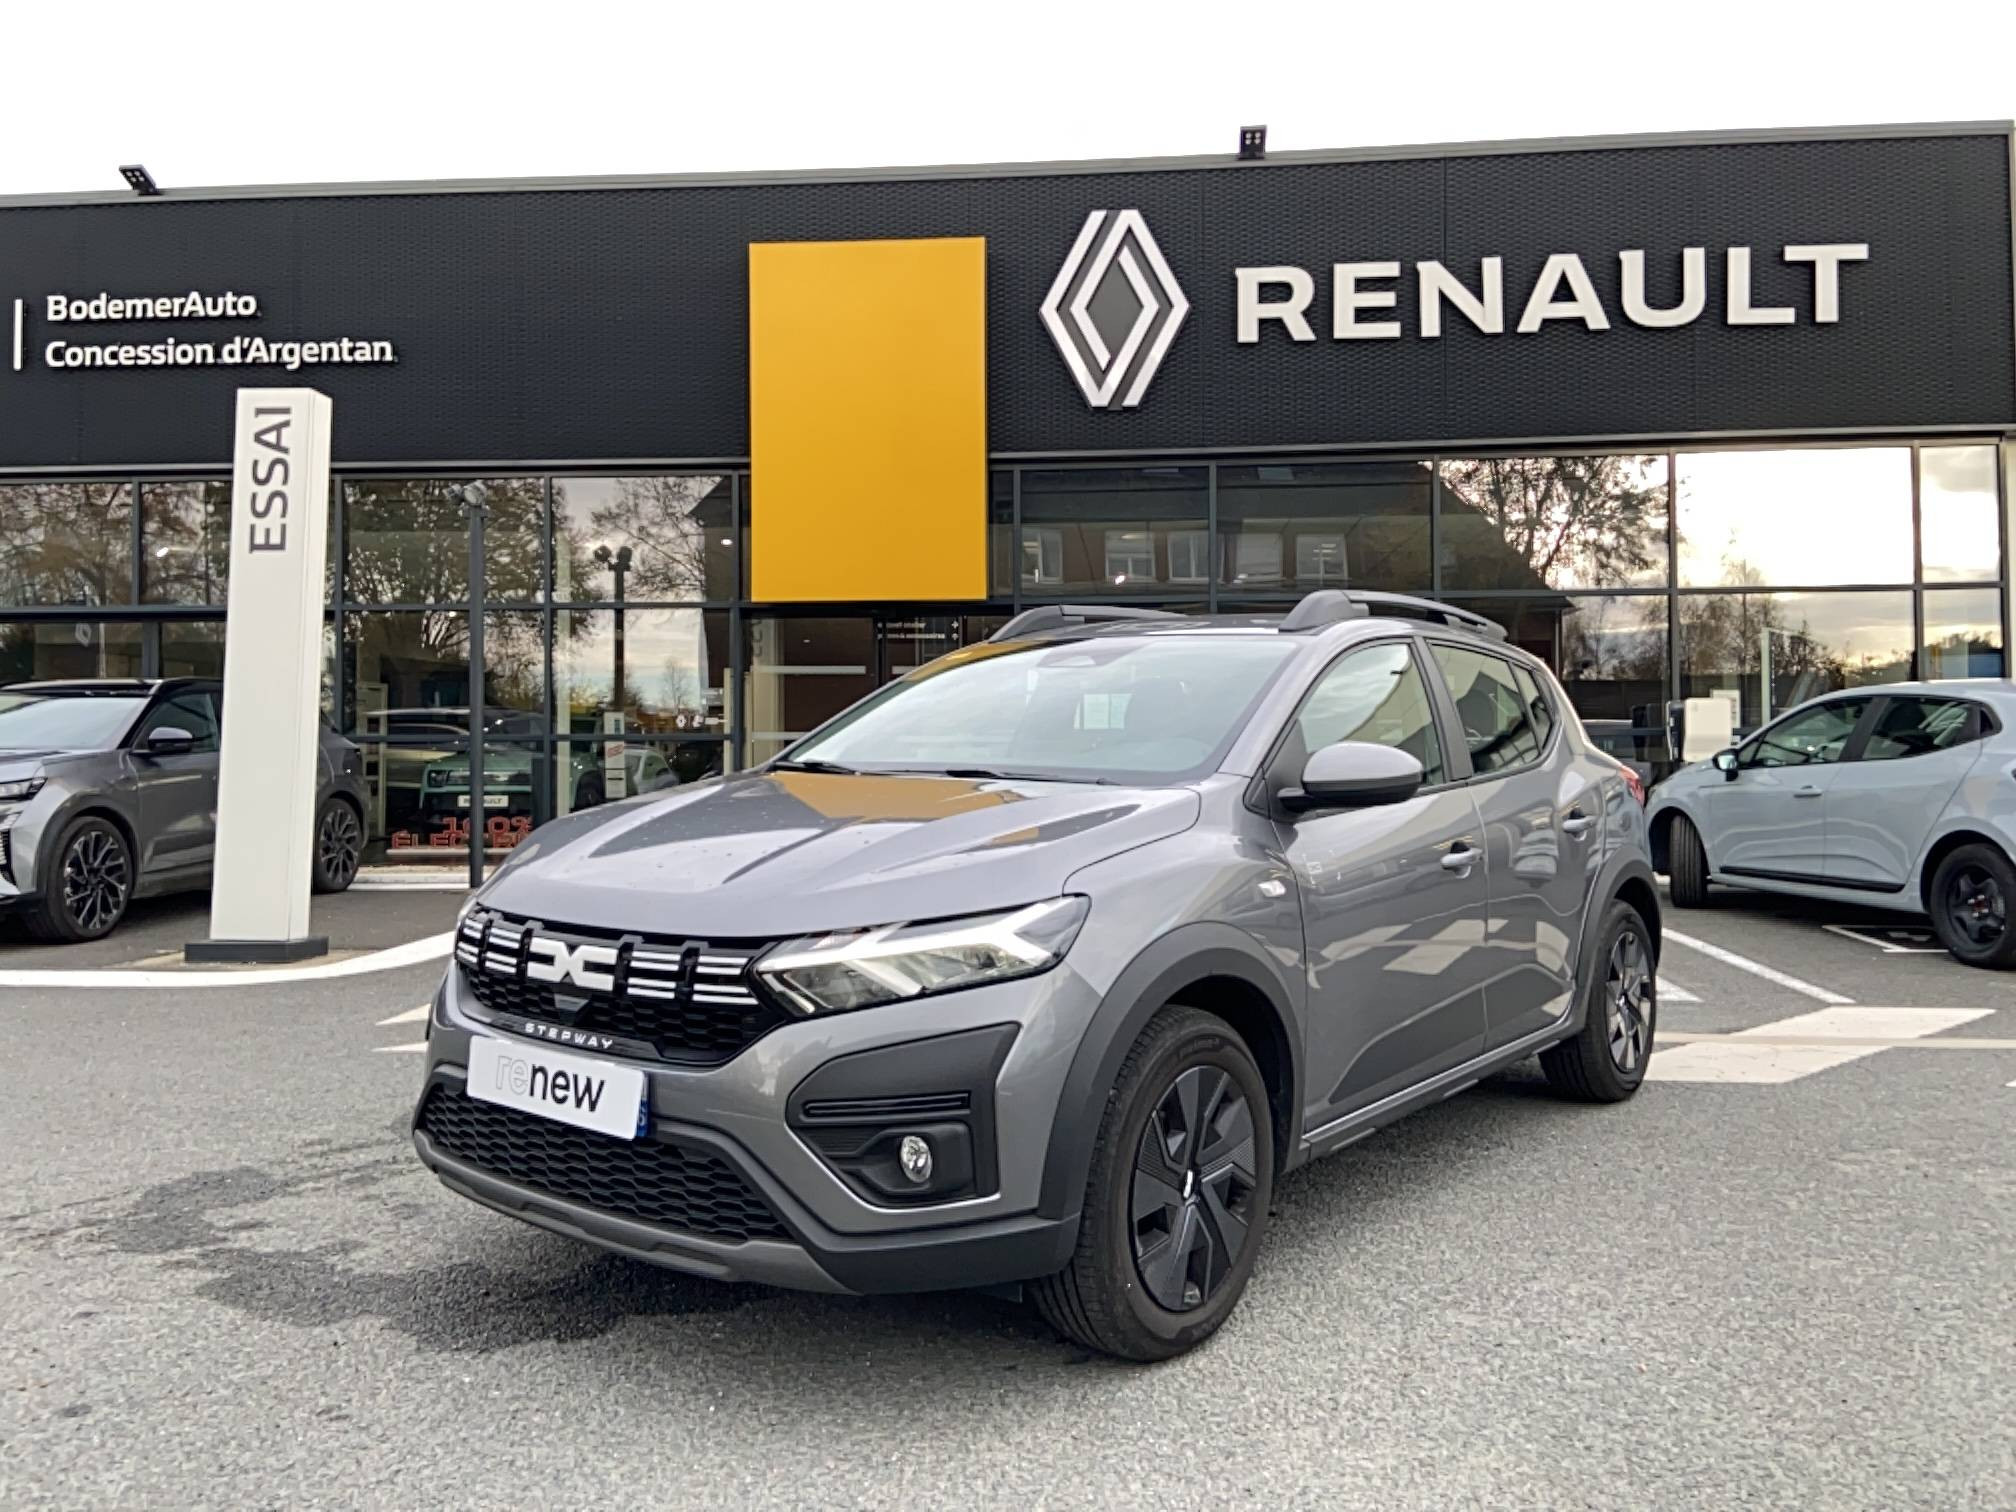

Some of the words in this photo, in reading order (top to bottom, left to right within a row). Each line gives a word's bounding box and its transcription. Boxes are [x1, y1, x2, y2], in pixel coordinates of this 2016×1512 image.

[46, 291, 258, 322] BodemerAuto
[1234, 242, 1870, 344] RENAULT
[45, 338, 215, 368] Concession
[221, 336, 394, 370] d'Argentan
[248, 406, 293, 554] ESSAI
[525, 1022, 613, 1050] STEPWAY
[495, 1054, 606, 1113] renew
